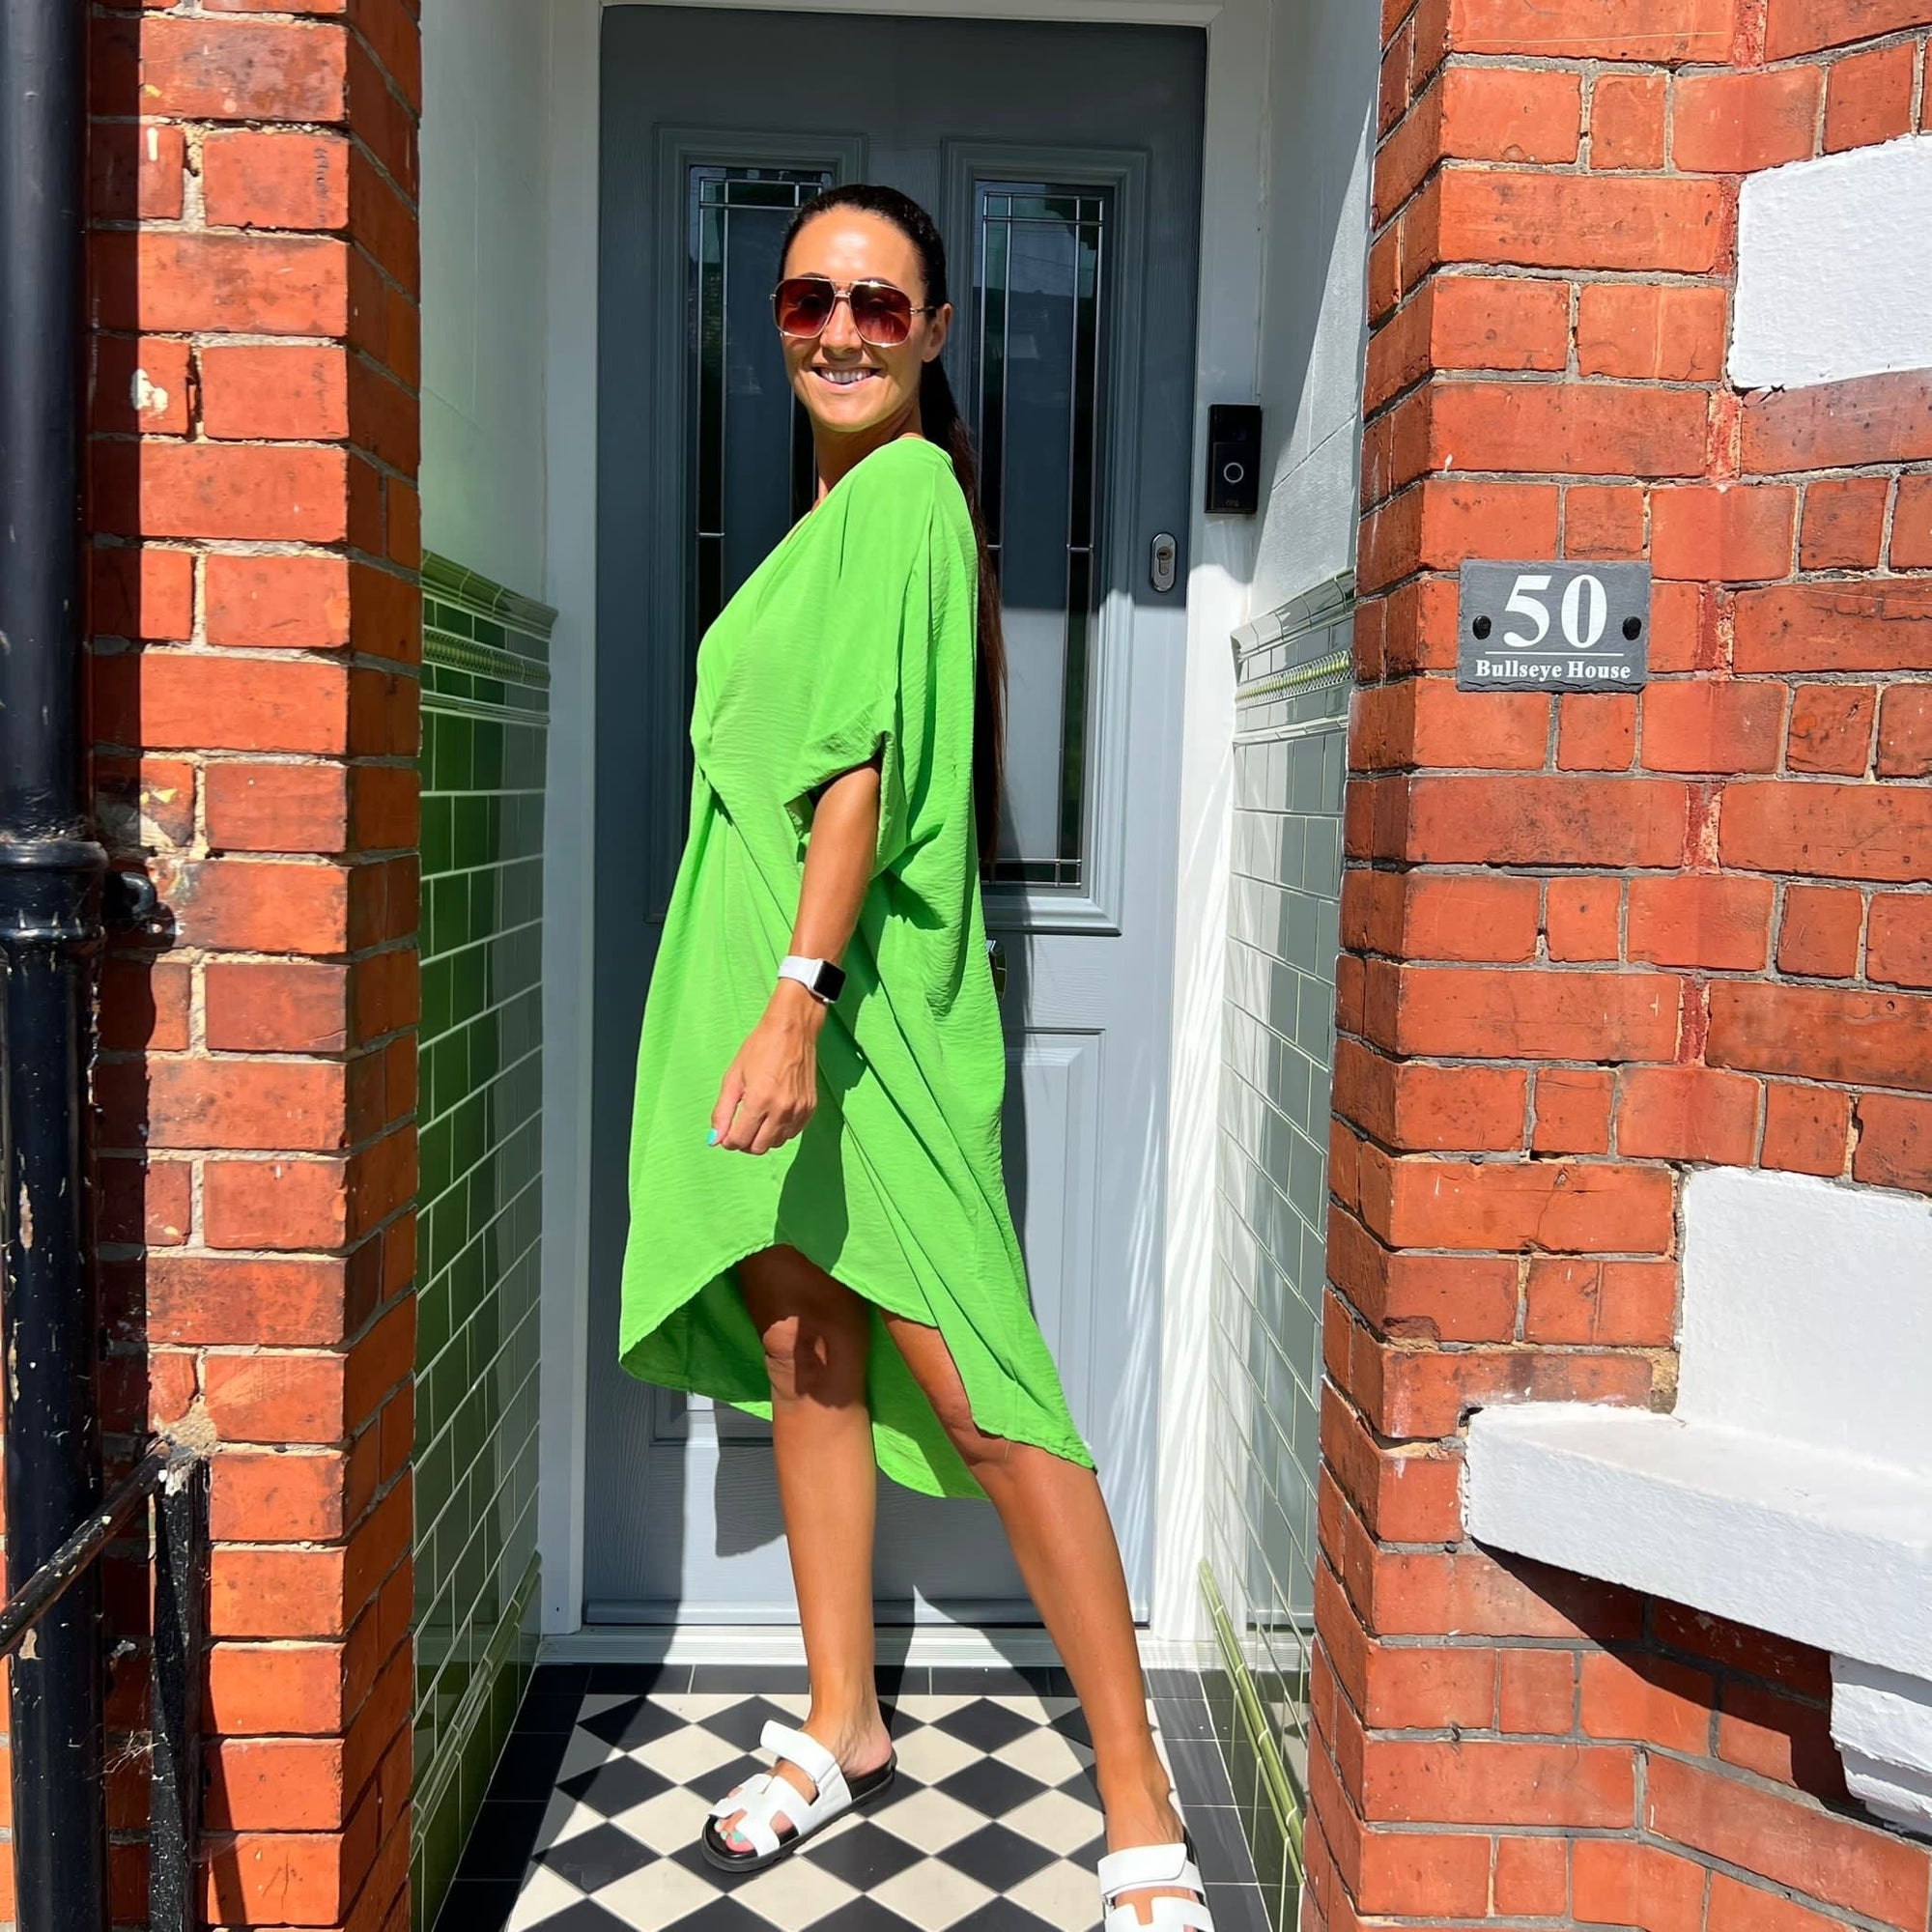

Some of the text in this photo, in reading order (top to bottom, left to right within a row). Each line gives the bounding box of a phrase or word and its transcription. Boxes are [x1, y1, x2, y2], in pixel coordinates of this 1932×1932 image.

[1503, 574, 1607, 649] 50
[1475, 660, 1631, 682] Bullseye House
